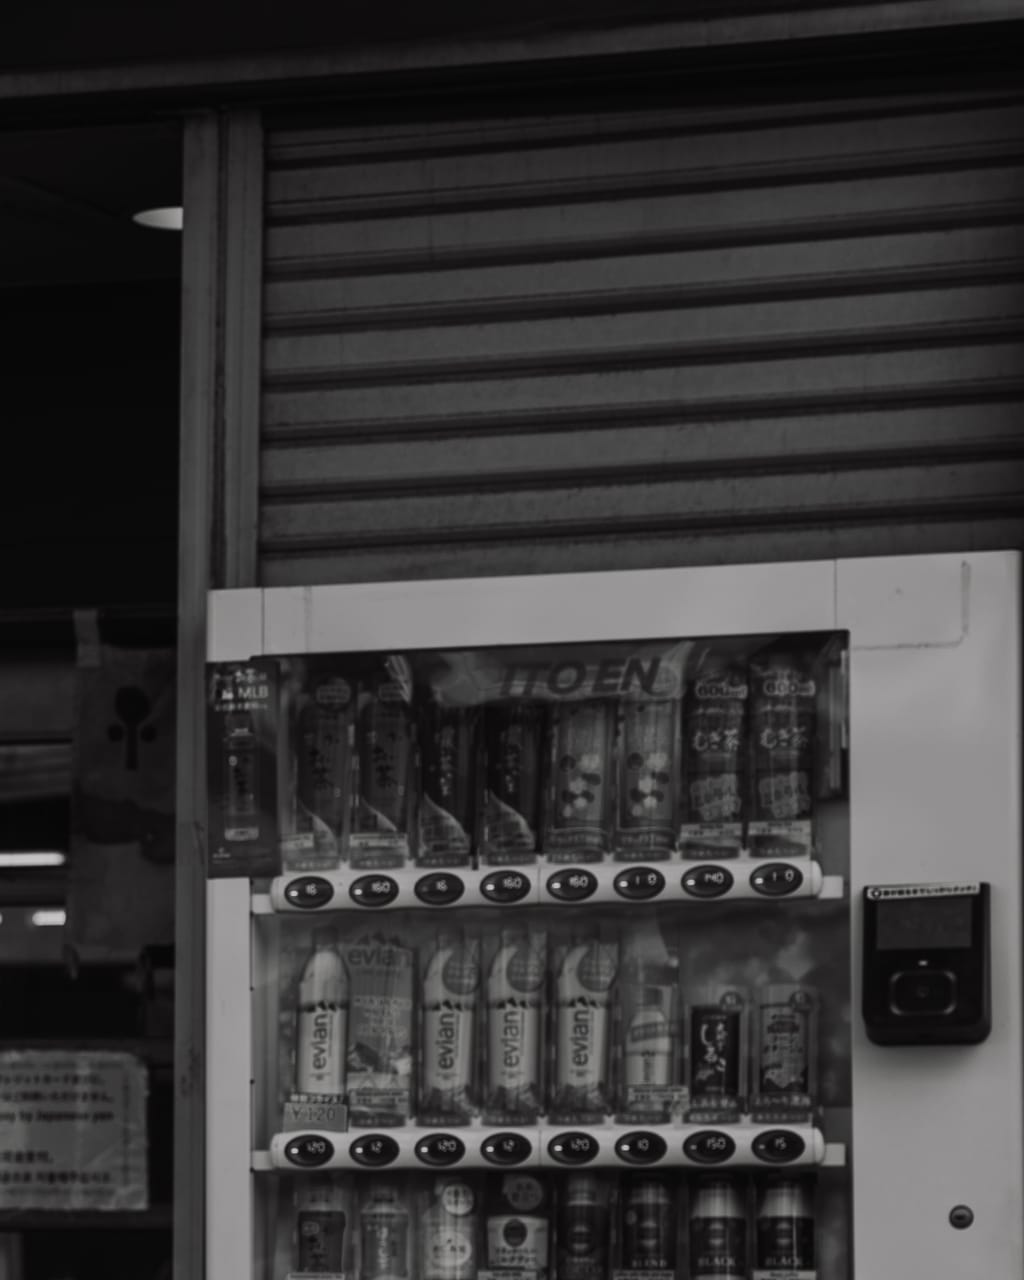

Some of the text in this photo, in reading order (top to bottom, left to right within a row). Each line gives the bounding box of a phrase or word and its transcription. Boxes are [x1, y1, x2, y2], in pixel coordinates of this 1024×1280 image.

[312, 1013, 328, 1069] evian
[438, 1011, 454, 1069] evian
[502, 1010, 520, 1068] evian
[570, 1003, 588, 1067] evian
[697, 1255, 736, 1267] BLACK
